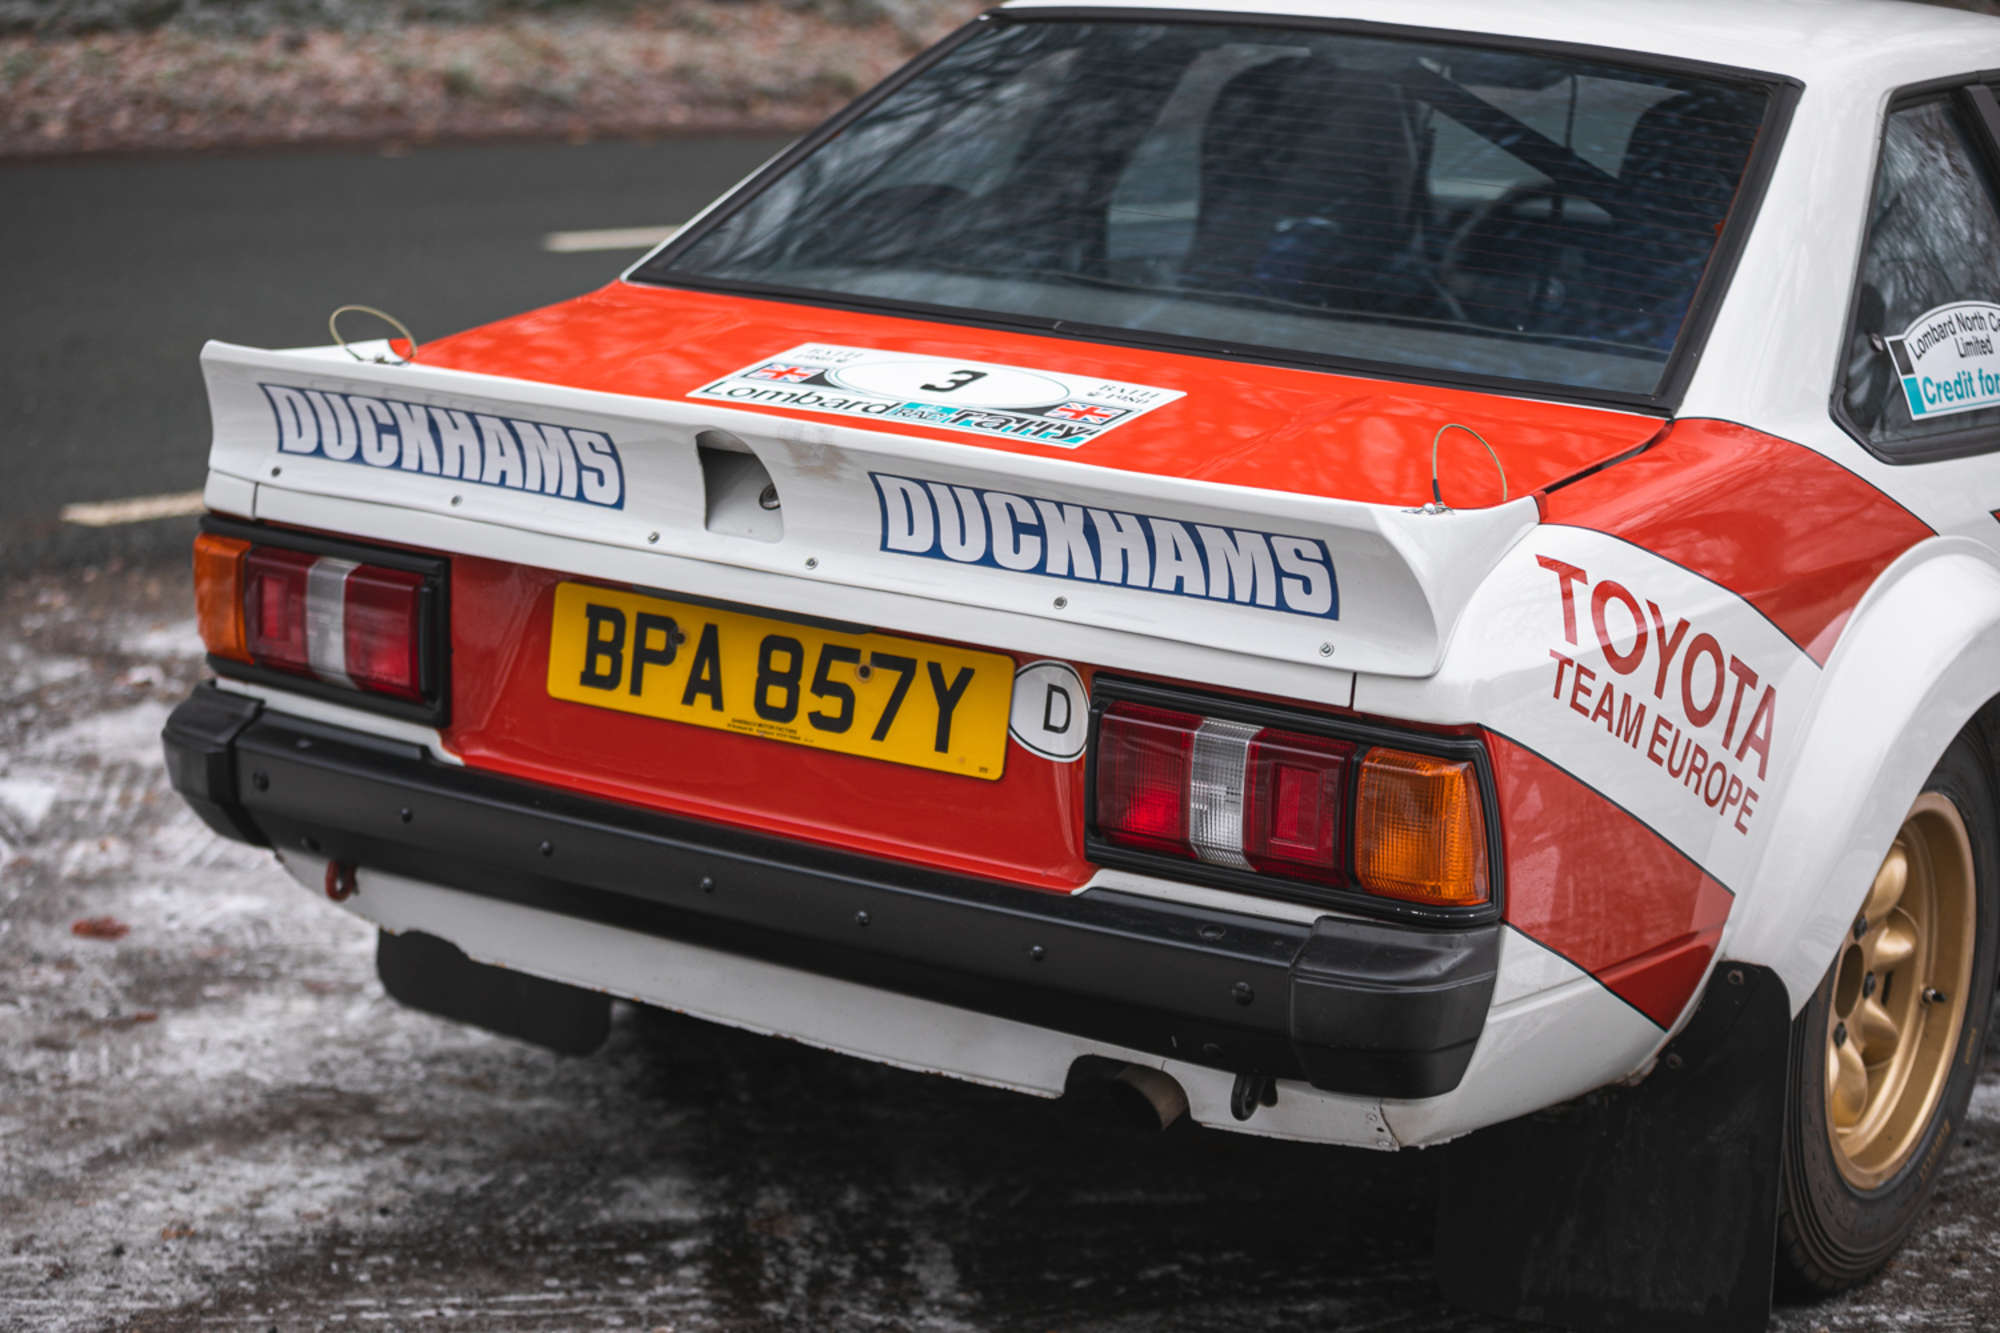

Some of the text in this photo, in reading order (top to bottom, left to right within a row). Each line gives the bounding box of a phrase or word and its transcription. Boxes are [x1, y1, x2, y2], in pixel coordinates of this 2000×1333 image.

[1908, 314, 1956, 360] Lombard
[1955, 311, 1987, 333] North
[1954, 334, 1994, 358] Limited
[702, 380, 902, 414] Lombard
[949, 409, 1098, 439] rally
[920, 370, 987, 392] 3
[1922, 370, 1976, 405] Credit
[259, 383, 624, 510] DUCKHAMS
[869, 472, 1339, 620] DUCKHAMS
[579, 603, 976, 754] BPA 857Y
[1535, 554, 1777, 782] TOYOTA
[1043, 683, 1071, 734] D
[1549, 649, 1760, 836] TEAM EUROPE
